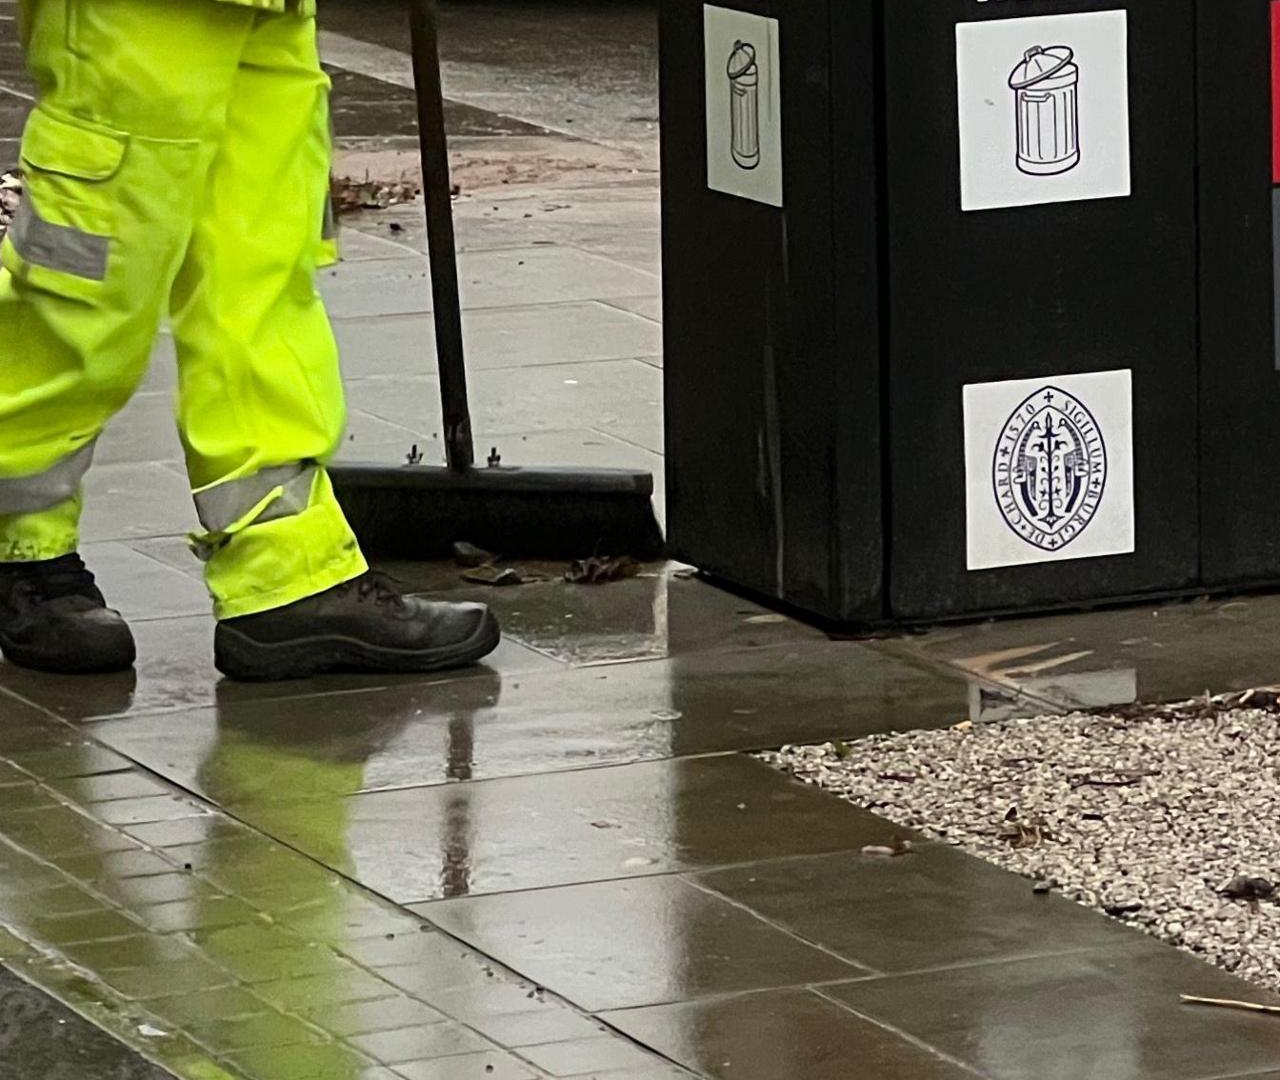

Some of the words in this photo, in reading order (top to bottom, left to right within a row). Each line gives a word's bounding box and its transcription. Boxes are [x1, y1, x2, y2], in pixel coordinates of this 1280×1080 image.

[1062, 399, 1104, 475] SIGILLUM
[997, 462, 1024, 527] CHARD
[1059, 491, 1101, 544] BURGI
[1027, 527, 1045, 545] DE
